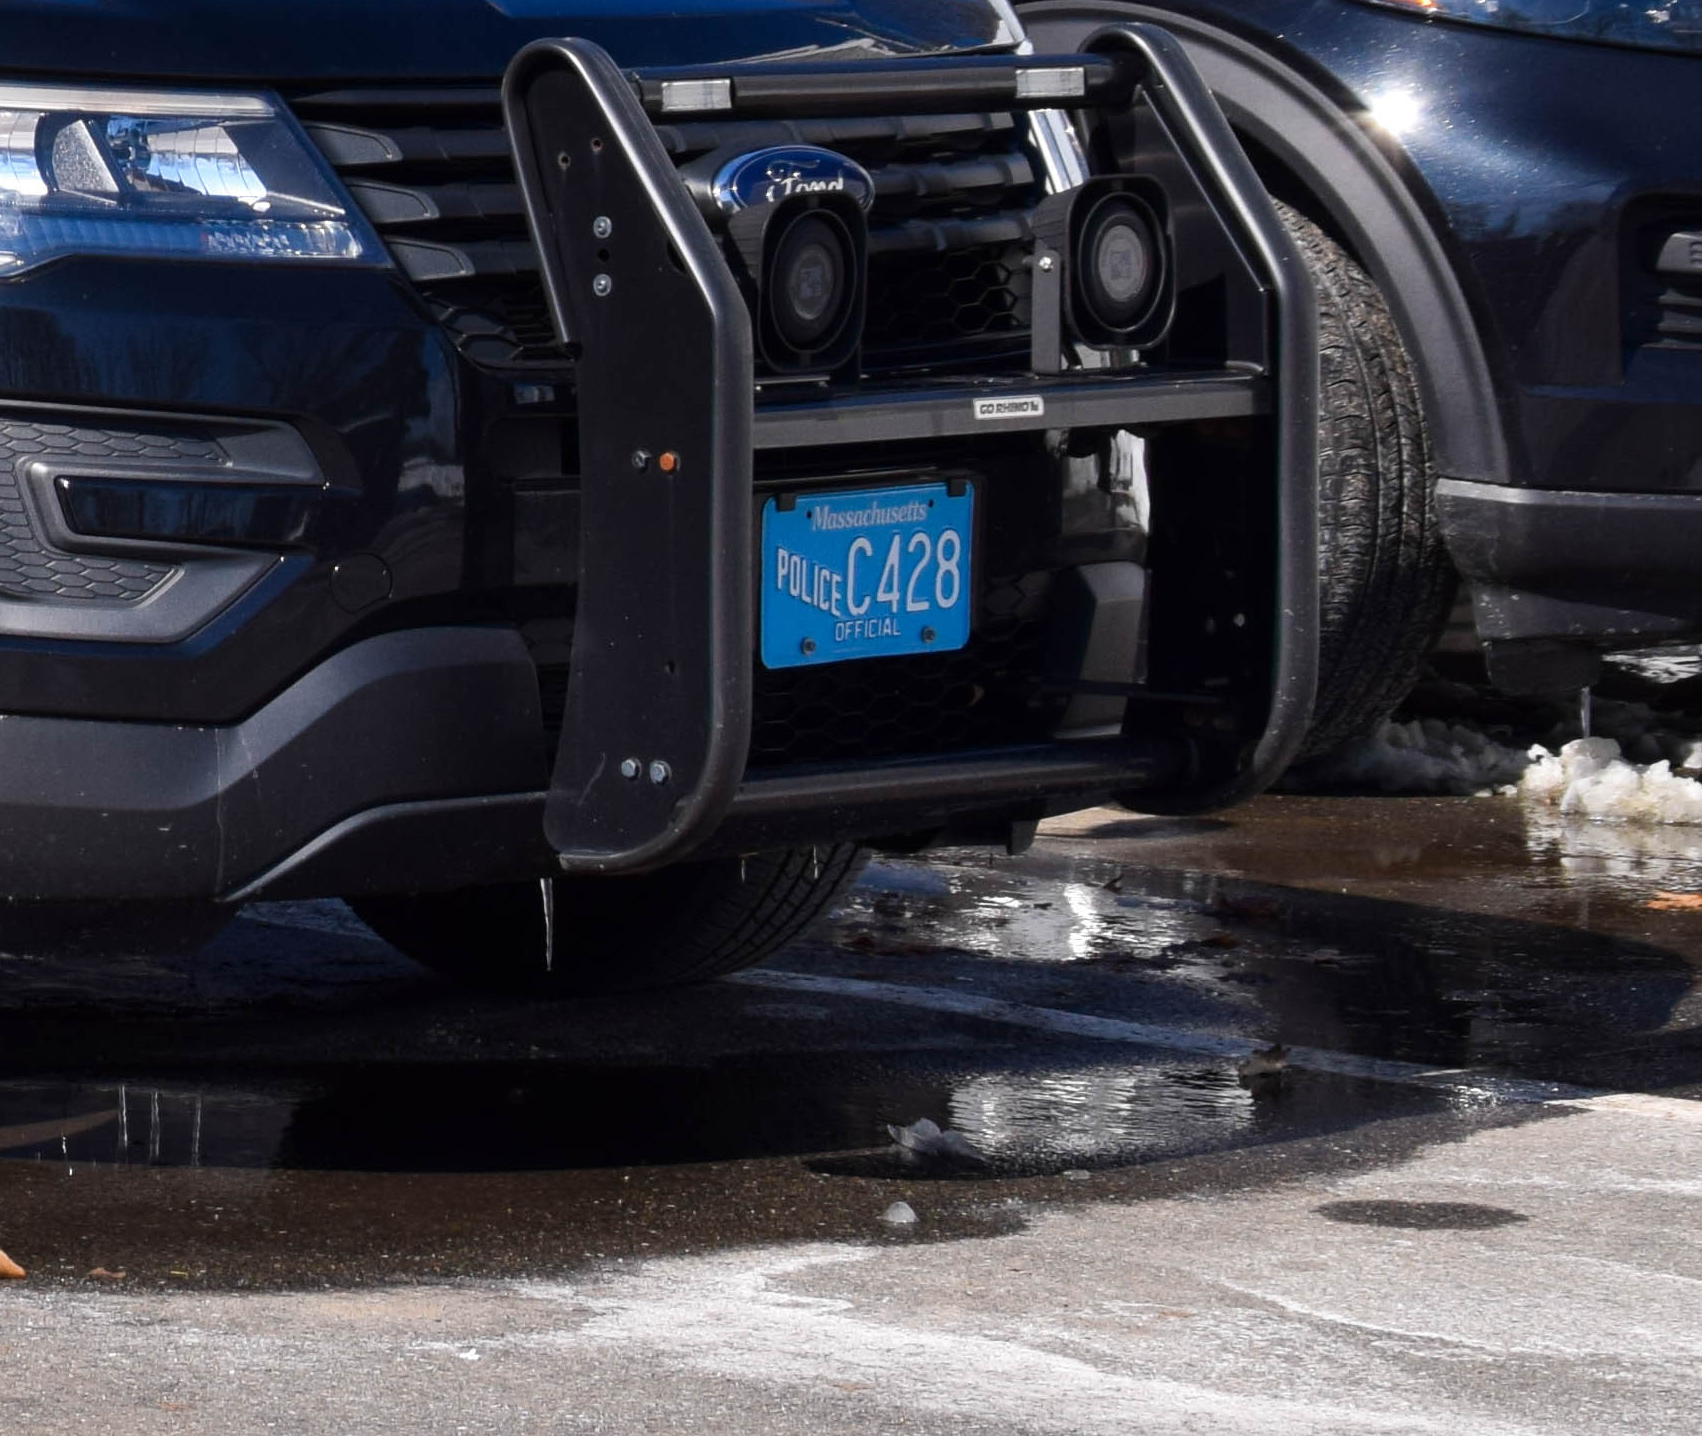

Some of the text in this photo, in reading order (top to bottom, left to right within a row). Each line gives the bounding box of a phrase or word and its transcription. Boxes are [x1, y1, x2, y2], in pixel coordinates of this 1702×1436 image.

[811, 500, 928, 531] Massachusetts
[777, 529, 961, 617] POLICE C428
[835, 619, 901, 642] OFFICIAL
